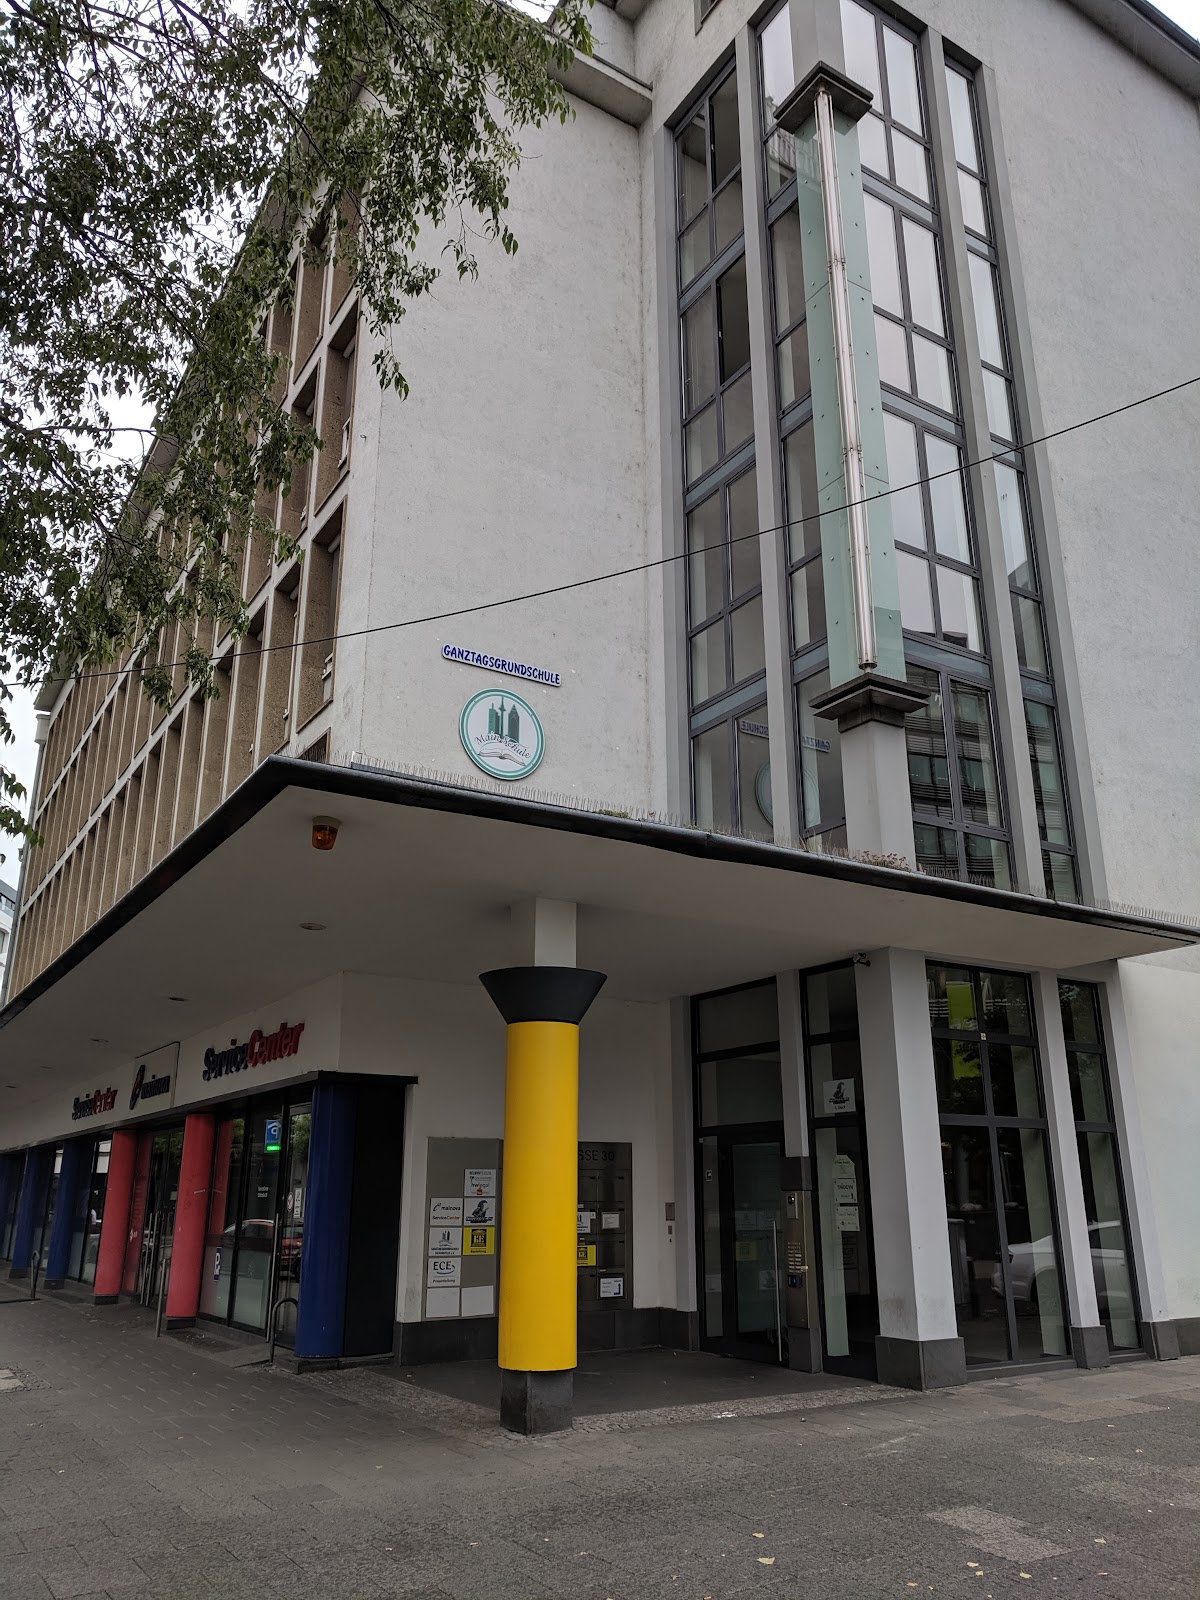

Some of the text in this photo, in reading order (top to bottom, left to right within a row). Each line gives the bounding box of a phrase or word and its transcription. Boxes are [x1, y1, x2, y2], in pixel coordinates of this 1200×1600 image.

[443, 644, 560, 685] GANZTAGSGRUNDSCHULE
[202, 1022, 304, 1082] ServiceCenter
[601, 1150, 615, 1161] 30
[433, 1260, 452, 1271] ECE
